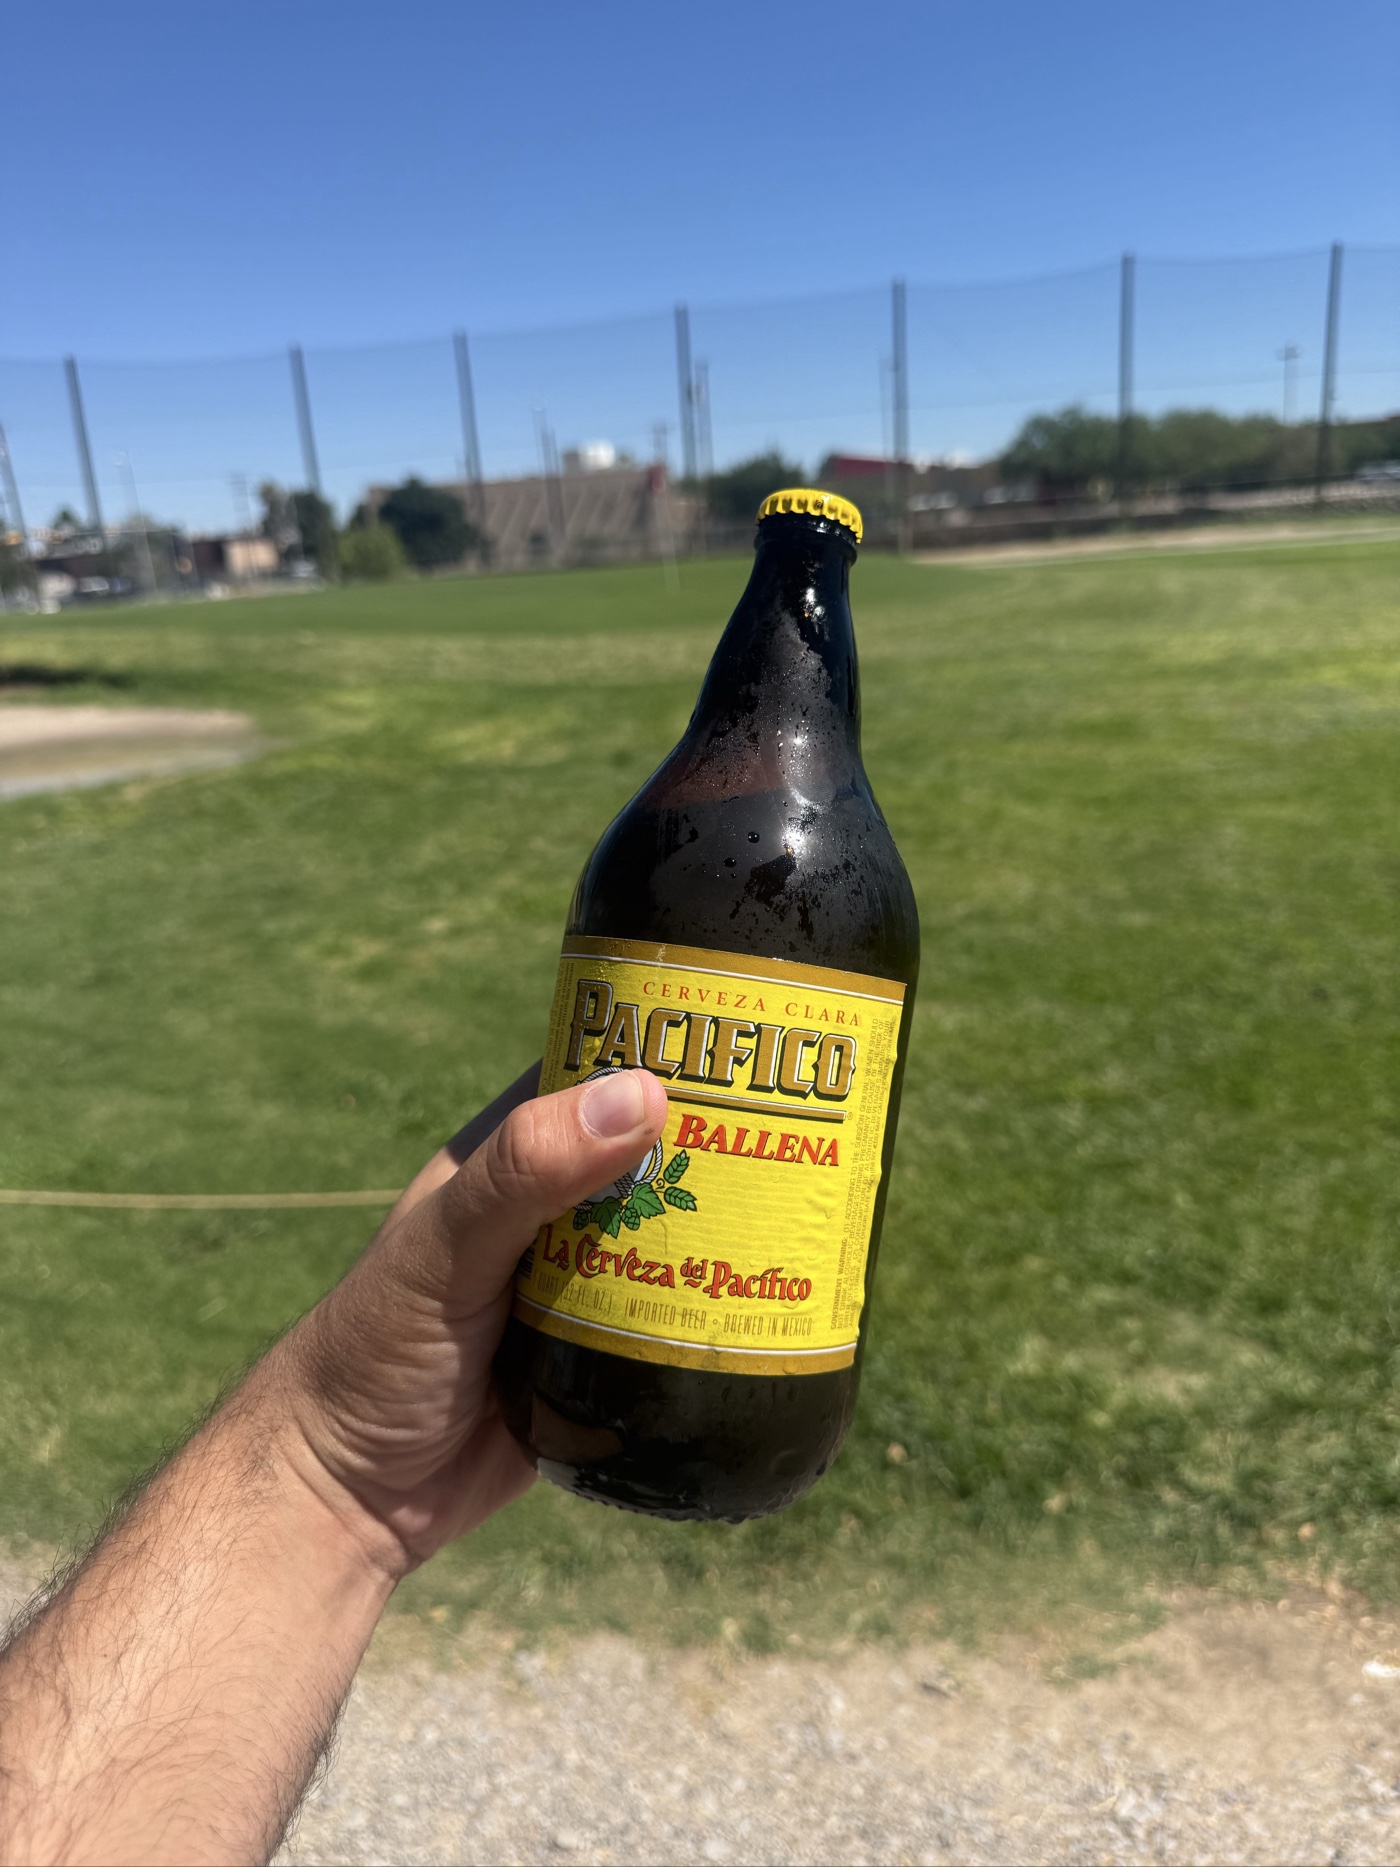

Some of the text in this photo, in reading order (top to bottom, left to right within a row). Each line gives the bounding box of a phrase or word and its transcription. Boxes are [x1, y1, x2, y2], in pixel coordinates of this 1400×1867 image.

[564, 979, 857, 1102] PACIFICO
[643, 981, 859, 1026] CERVEZA CLARA
[673, 1114, 839, 1166] BALLENA
[830, 1278, 842, 1329] GOVERNMENT
[838, 1236, 848, 1275] WARNING:
[845, 1177, 856, 1220] ACCORDING
[851, 1165, 857, 1175] TO
[855, 1114, 864, 1148] SURGEON
[865, 1048, 873, 1076] WOMEN
[869, 1018, 877, 1047] SHOULD
[843, 1241, 853, 1284] ALCOHOLIC
[849, 1194, 860, 1238] BEVERAGES
[856, 1163, 864, 1192] DURING
[860, 1115, 870, 1161] PREGNANCY
[866, 1081, 875, 1113] BECAUSE
[871, 1068, 877, 1077] OF
[878, 1019, 883, 1029] OF
[855, 1187, 866, 1245] CONSUMPTION
[863, 1175, 868, 1184] OF
[543, 1223, 812, 1301] La Cerveza del Pacífico
[538, 1272, 560, 1294] QUART
[560, 1278, 575, 1303] (32
[576, 1285, 589, 1308] FL.
[593, 1289, 613, 1316] OZ.)
[624, 1297, 676, 1326] IMPORTED
[680, 1308, 707, 1330] BEER
[723, 1313, 764, 1336] BREWED
[767, 1316, 779, 1337] IN
[781, 1316, 813, 1337] MEXICO
